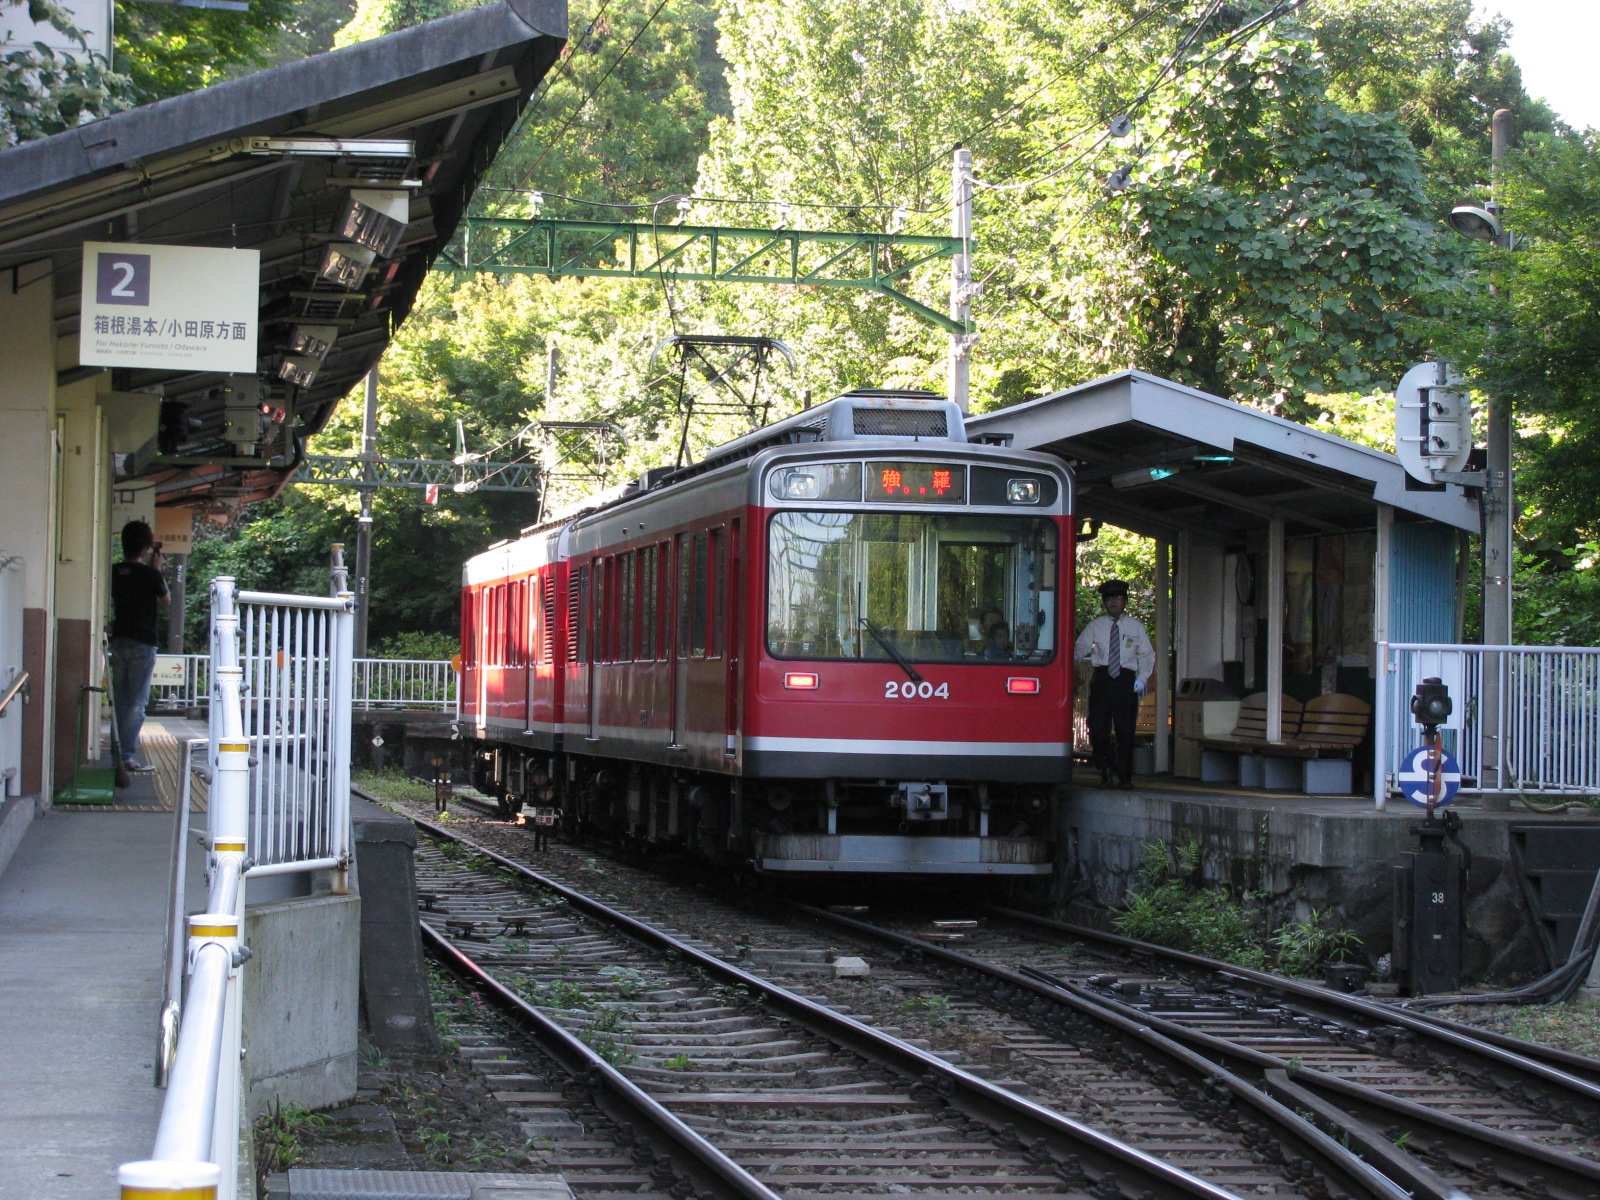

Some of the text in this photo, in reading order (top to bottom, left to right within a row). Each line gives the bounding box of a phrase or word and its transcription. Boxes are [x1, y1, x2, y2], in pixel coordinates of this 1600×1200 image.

[111, 262, 135, 297] 2
[94, 314, 247, 341] 箱根湯本/小田原方面
[95, 339, 108, 347] For
[174, 344, 207, 352] Odawara
[885, 681, 949, 699] 2004
[1431, 892, 1444, 904] 38
